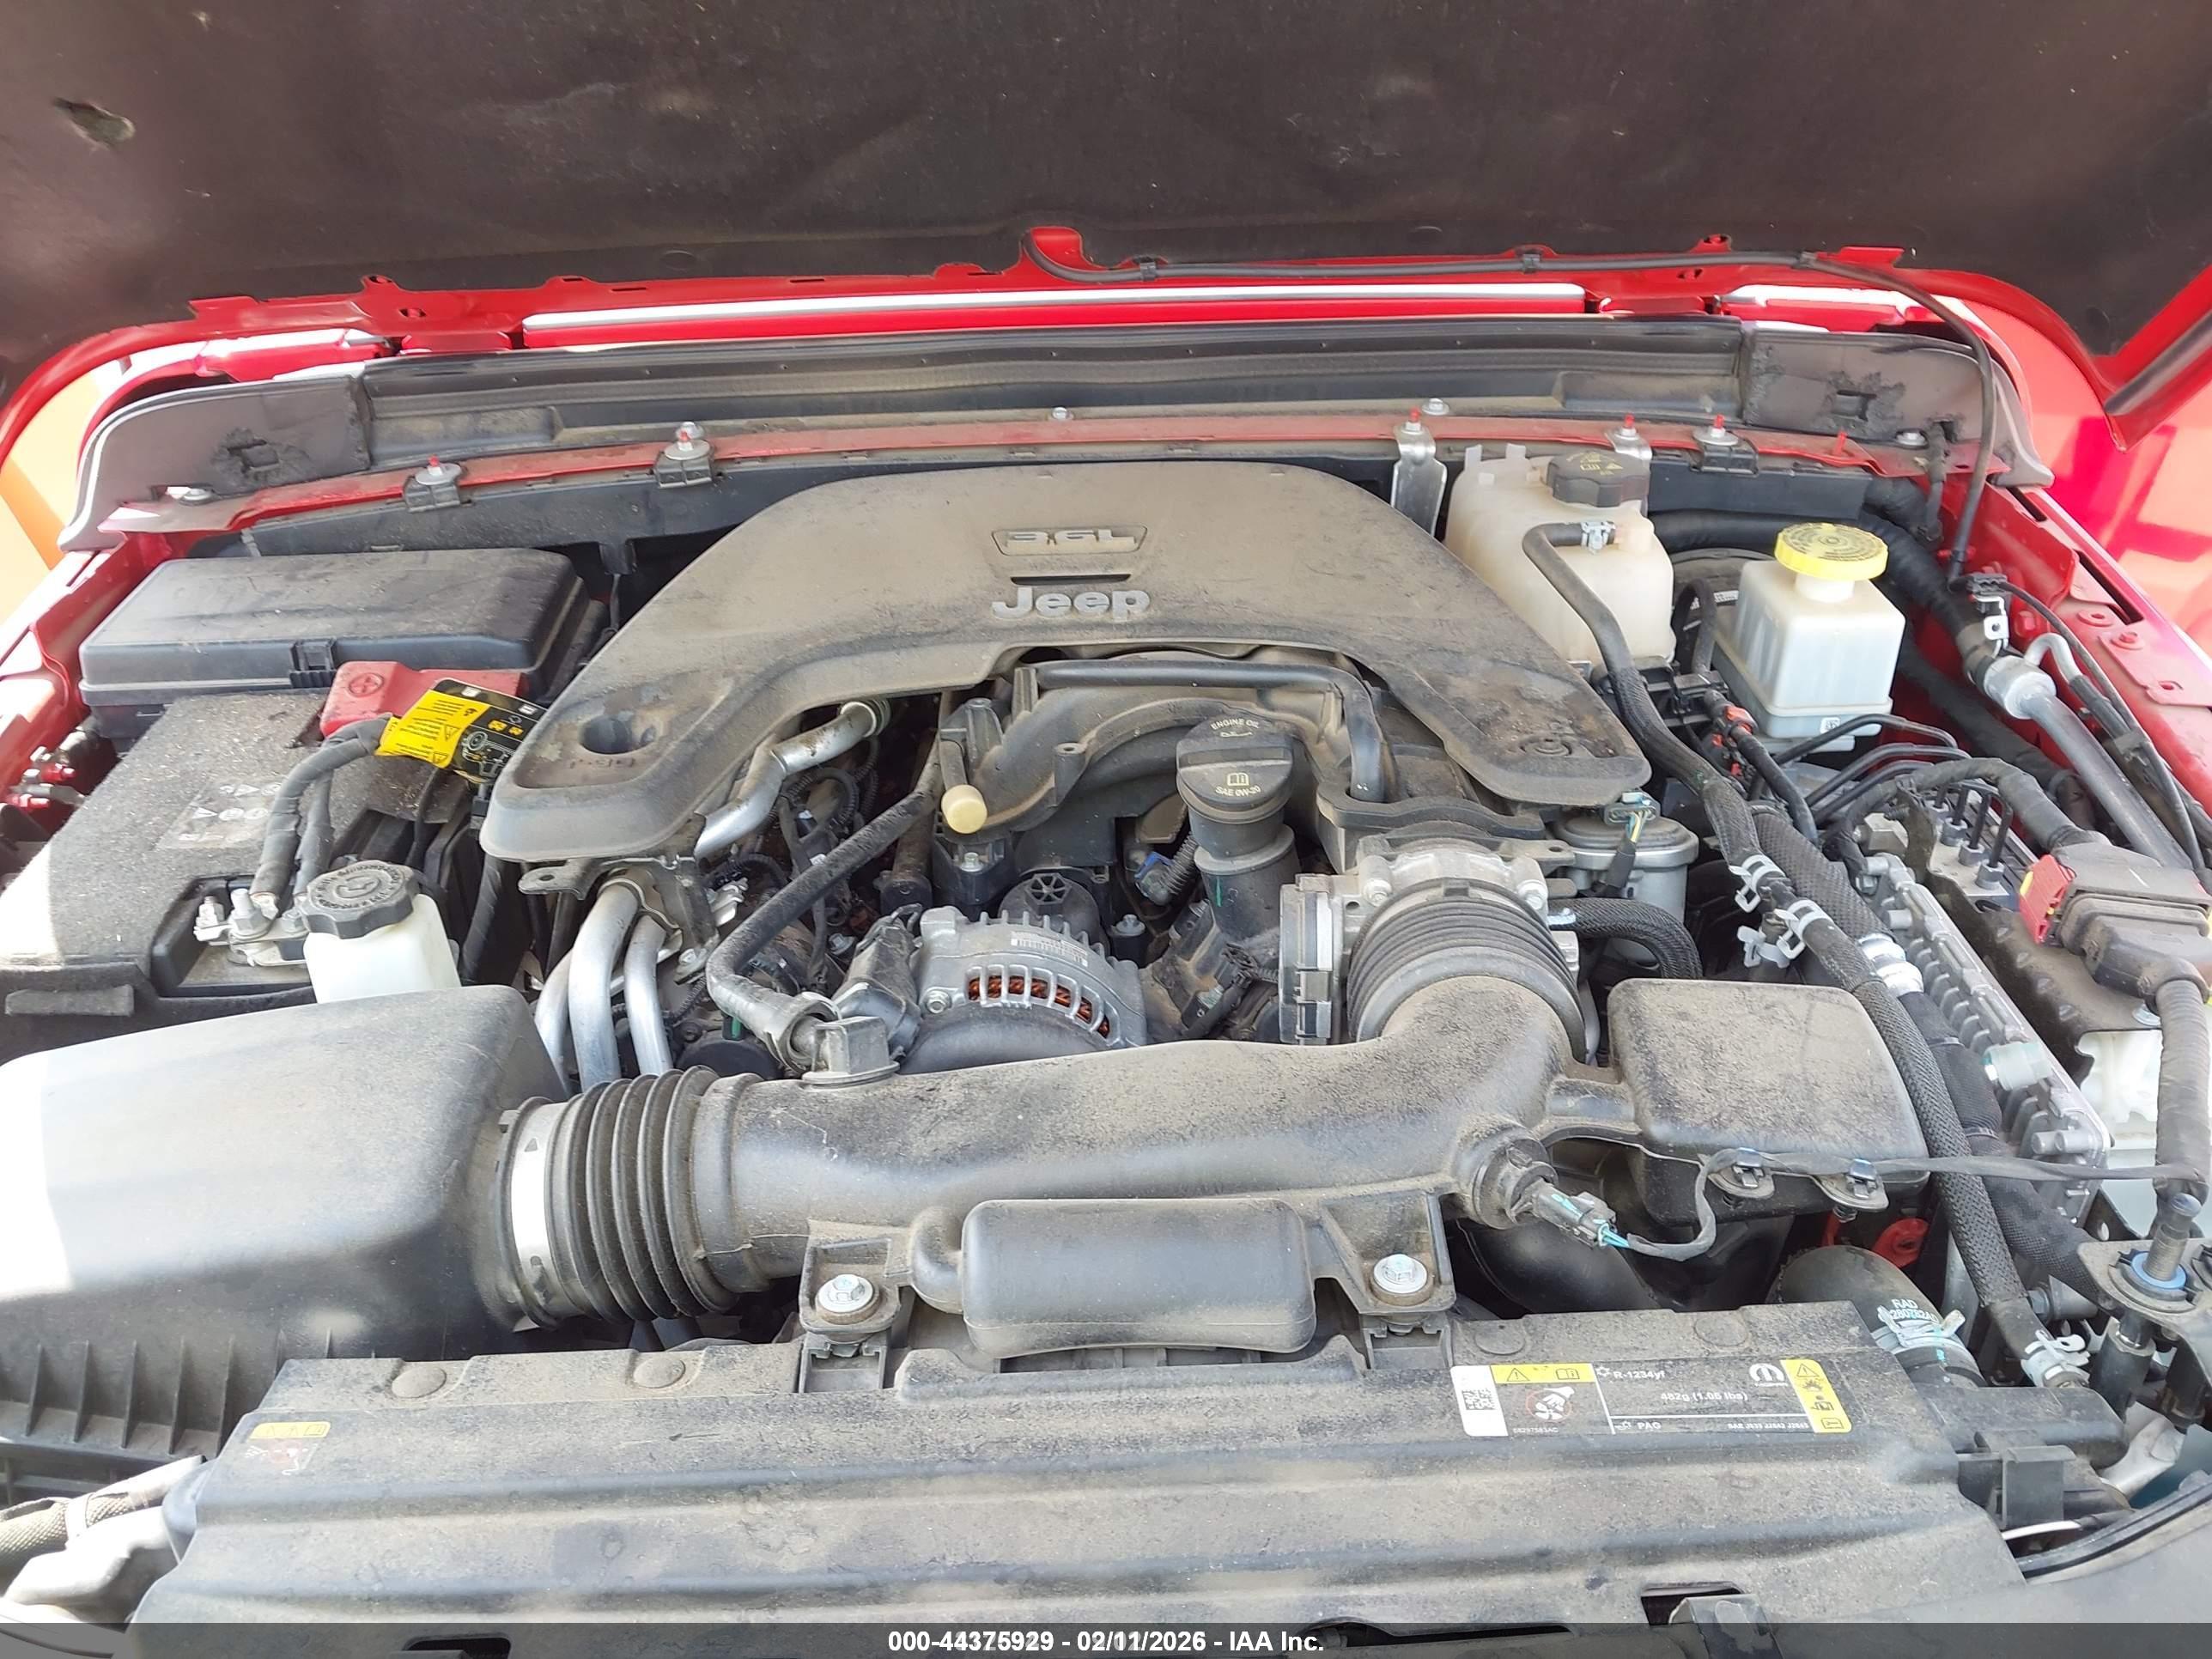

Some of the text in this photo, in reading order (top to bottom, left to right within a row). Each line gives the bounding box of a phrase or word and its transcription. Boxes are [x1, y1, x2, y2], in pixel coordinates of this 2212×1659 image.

[992, 586, 1151, 622] Jeep
[1210, 718, 1244, 730] ENGINE
[1215, 784, 1261, 797] SAE 0W-20
[1891, 1298, 1919, 1310] RAD
[1613, 1370, 1665, 1381] R-1234yf
[1637, 1421, 1662, 1431] PAG
